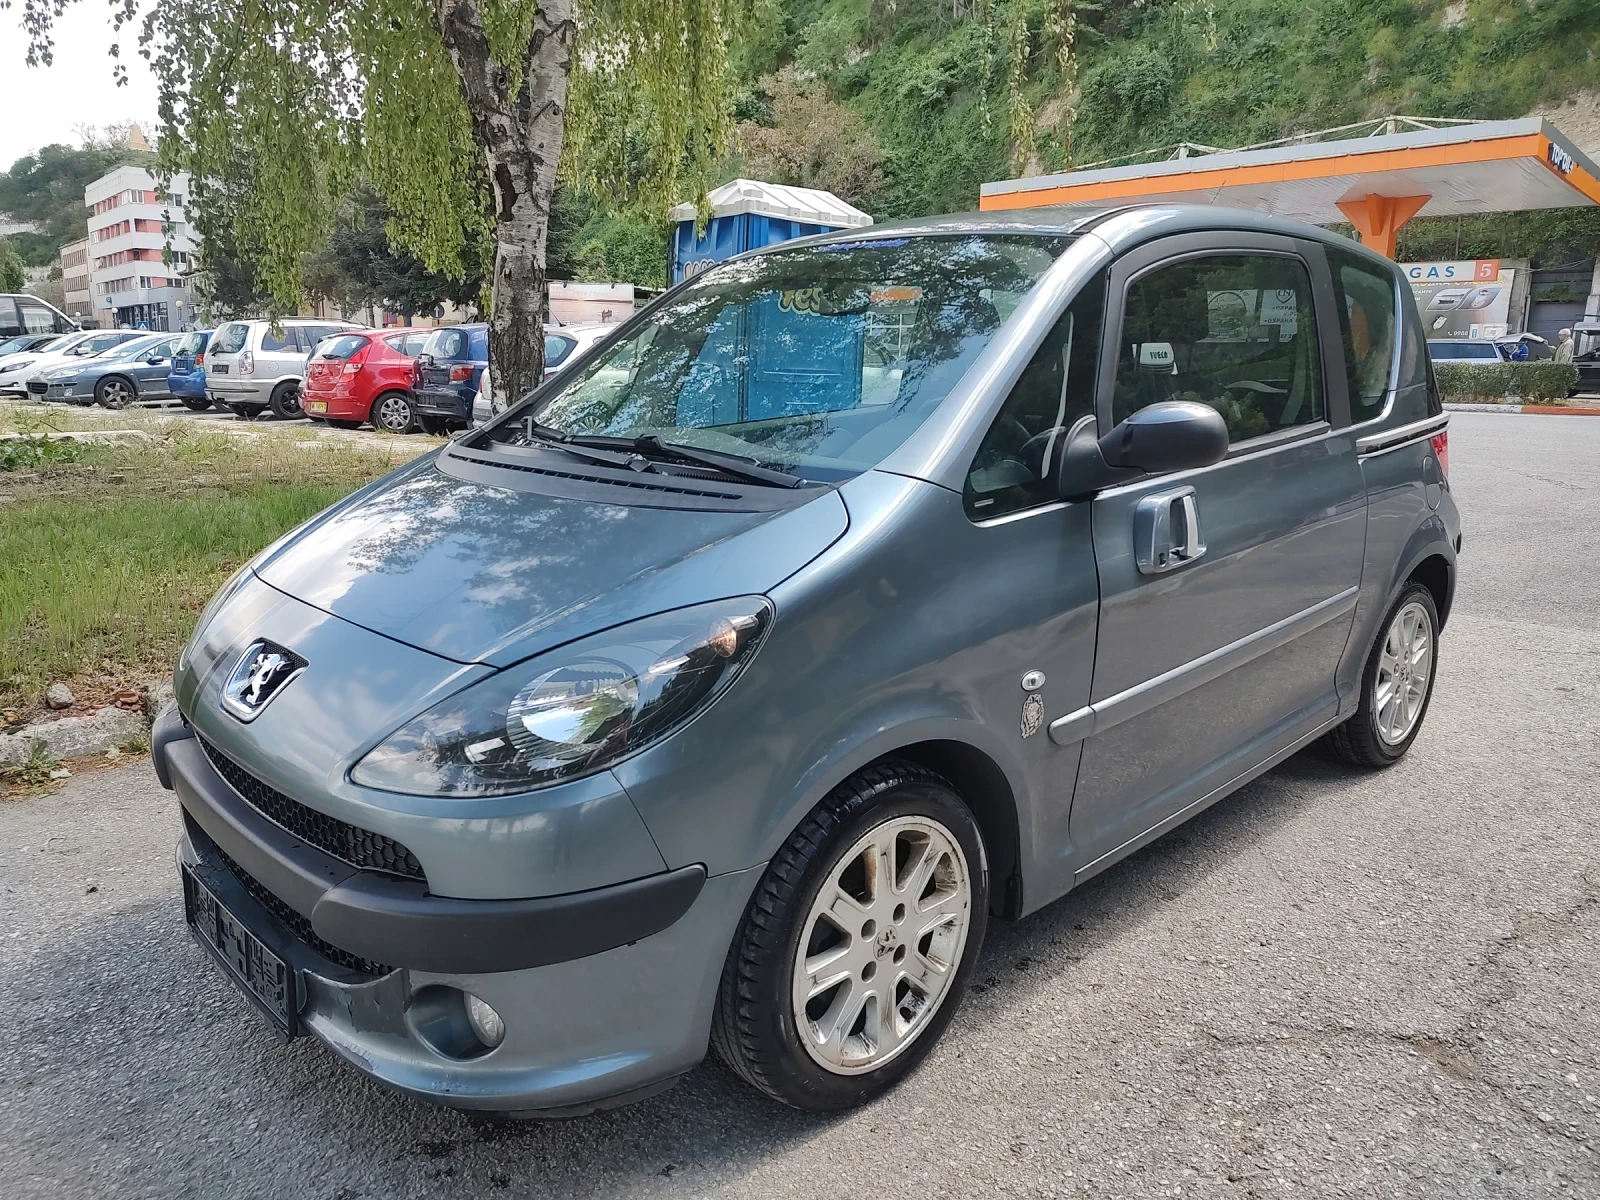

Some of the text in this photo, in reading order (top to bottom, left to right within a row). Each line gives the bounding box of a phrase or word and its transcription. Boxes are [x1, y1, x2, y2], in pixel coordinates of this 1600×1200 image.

[1409, 263, 1492, 279] GAS 5
[1150, 351, 1168, 360] IVECO
